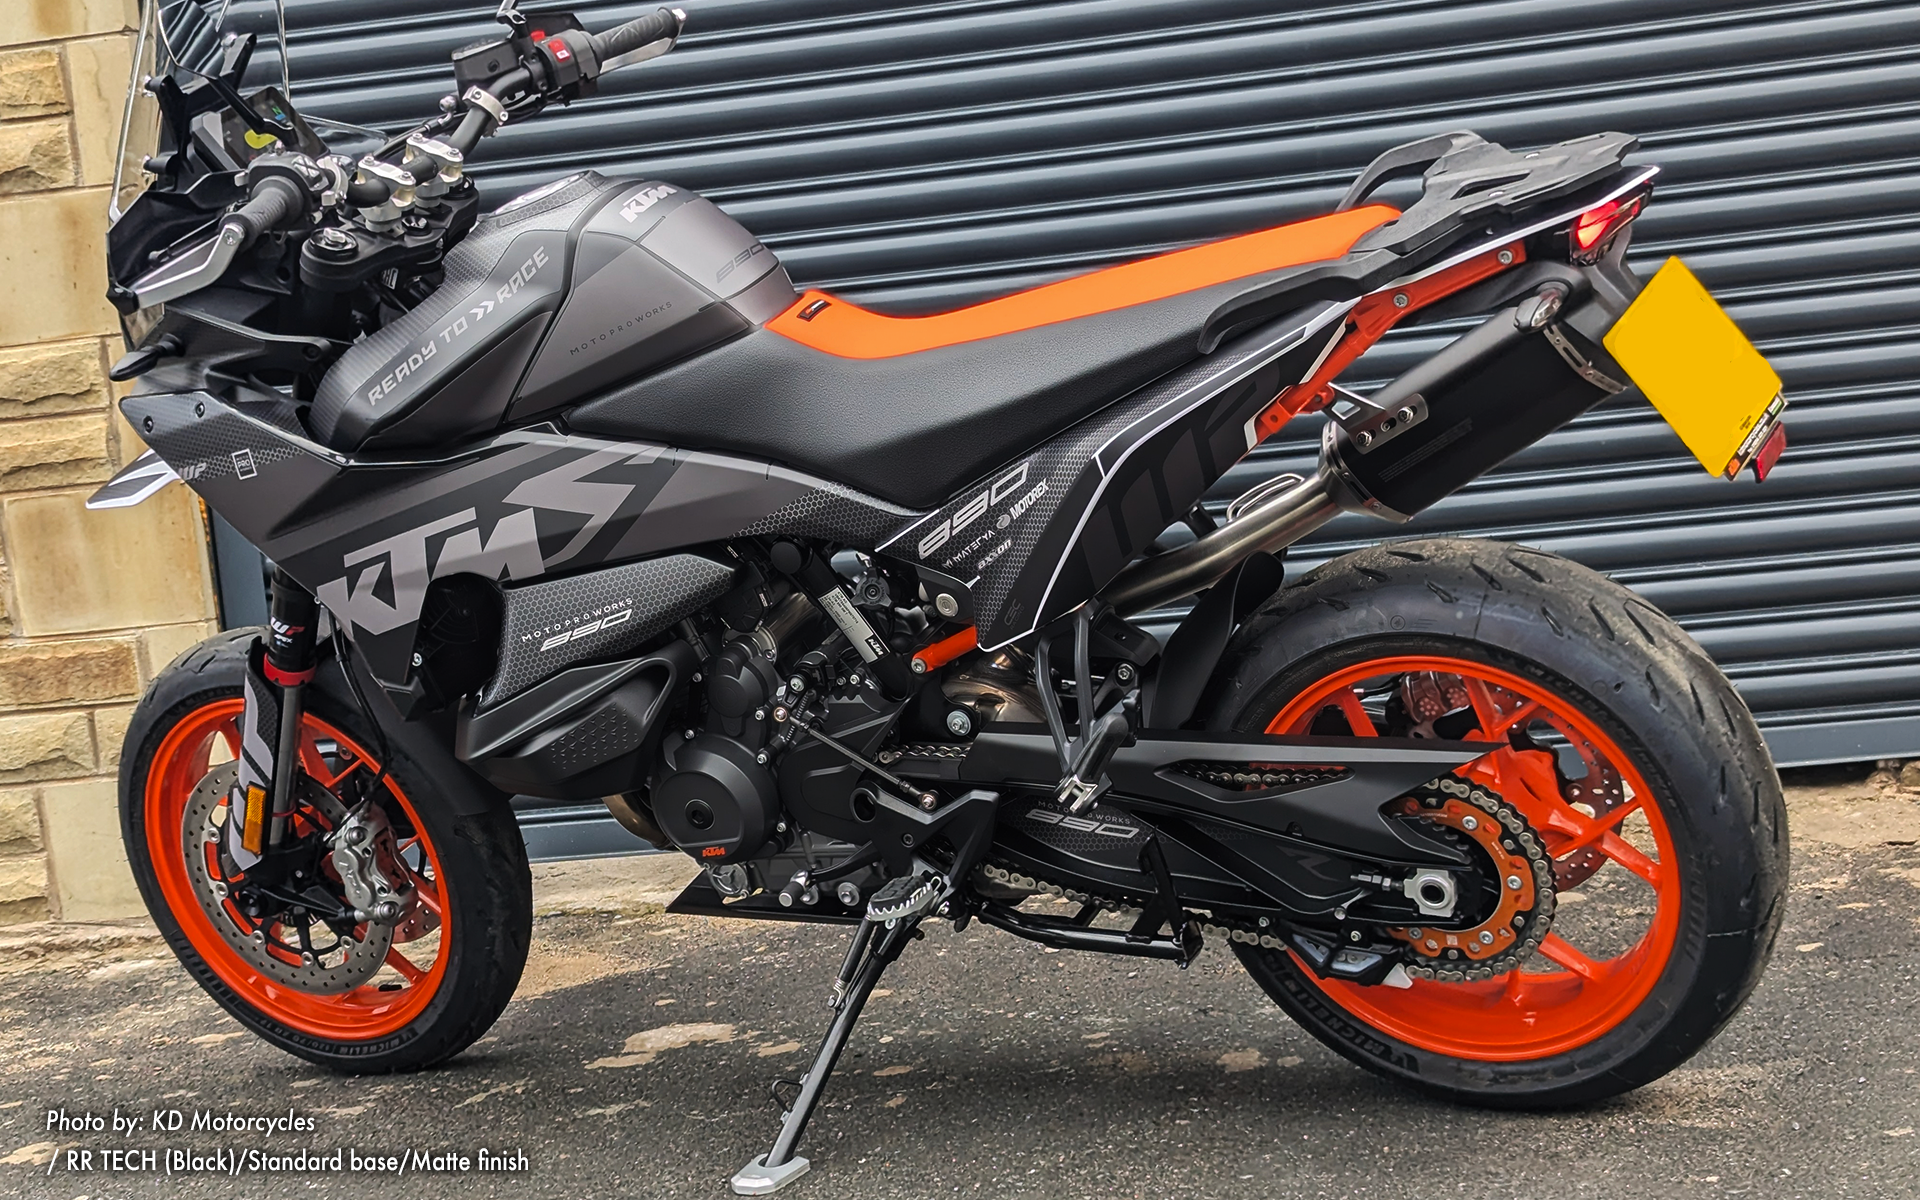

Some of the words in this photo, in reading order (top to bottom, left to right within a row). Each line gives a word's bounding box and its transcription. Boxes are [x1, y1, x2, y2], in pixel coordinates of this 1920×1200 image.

[619, 185, 678, 223] KTM
[367, 340, 438, 406] READY
[439, 316, 469, 344] TO
[495, 246, 550, 304] RACE
[1009, 478, 1050, 520] MOTOREX
[316, 506, 546, 641] KTM
[867, 638, 884, 656] KTM
[702, 846, 726, 858] KTM
[1282, 976, 1387, 1056] MICHELIN
[338, 1037, 401, 1056] MICHELIN
